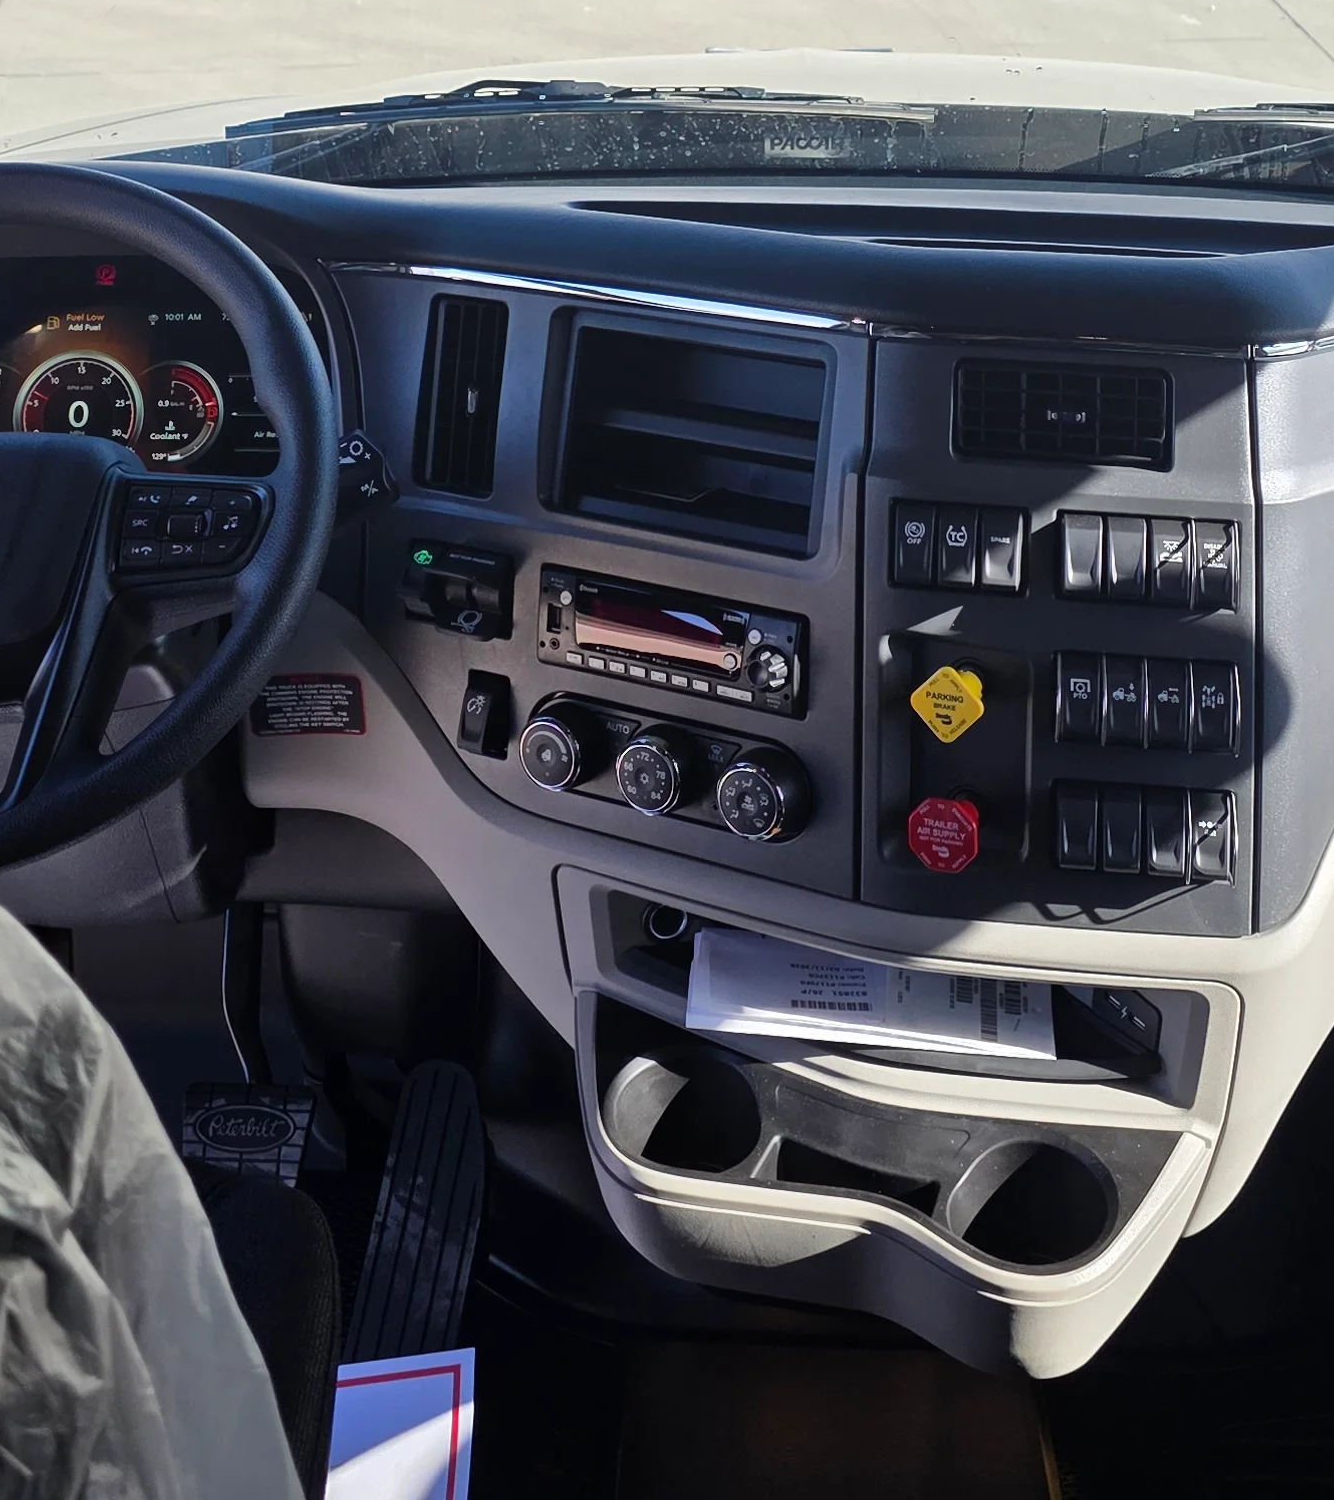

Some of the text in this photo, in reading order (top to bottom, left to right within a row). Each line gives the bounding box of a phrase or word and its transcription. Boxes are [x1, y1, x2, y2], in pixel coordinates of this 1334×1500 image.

[65, 313, 106, 322] Fuel Low
[164, 313, 202, 321] 10:01 AM
[68, 323, 102, 332] Add Fuel
[77, 366, 87, 375] 15
[50, 377, 60, 385] 10
[101, 377, 112, 385] 20
[115, 399, 126, 407] 25
[68, 400, 90, 428] 0
[111, 429, 122, 437] 30
[150, 432, 181, 440] Coolant
[132, 517, 150, 528] SRC
[907, 537, 922, 545] OFF
[949, 531, 964, 542] TC
[990, 536, 1011, 544] SPARE
[925, 690, 964, 704] PARKING
[1073, 692, 1088, 700] PTO
[933, 702, 957, 712] BRAKE
[605, 721, 631, 735] AUTO
[639, 751, 650, 761] 72
[707, 752, 726, 764] MAX
[655, 770, 666, 779] 78
[650, 791, 662, 801] 84
[924, 818, 959, 831] TRAILER
[916, 826, 967, 841] AIR SUPPLY
[208, 1113, 286, 1139] Peterbilt
